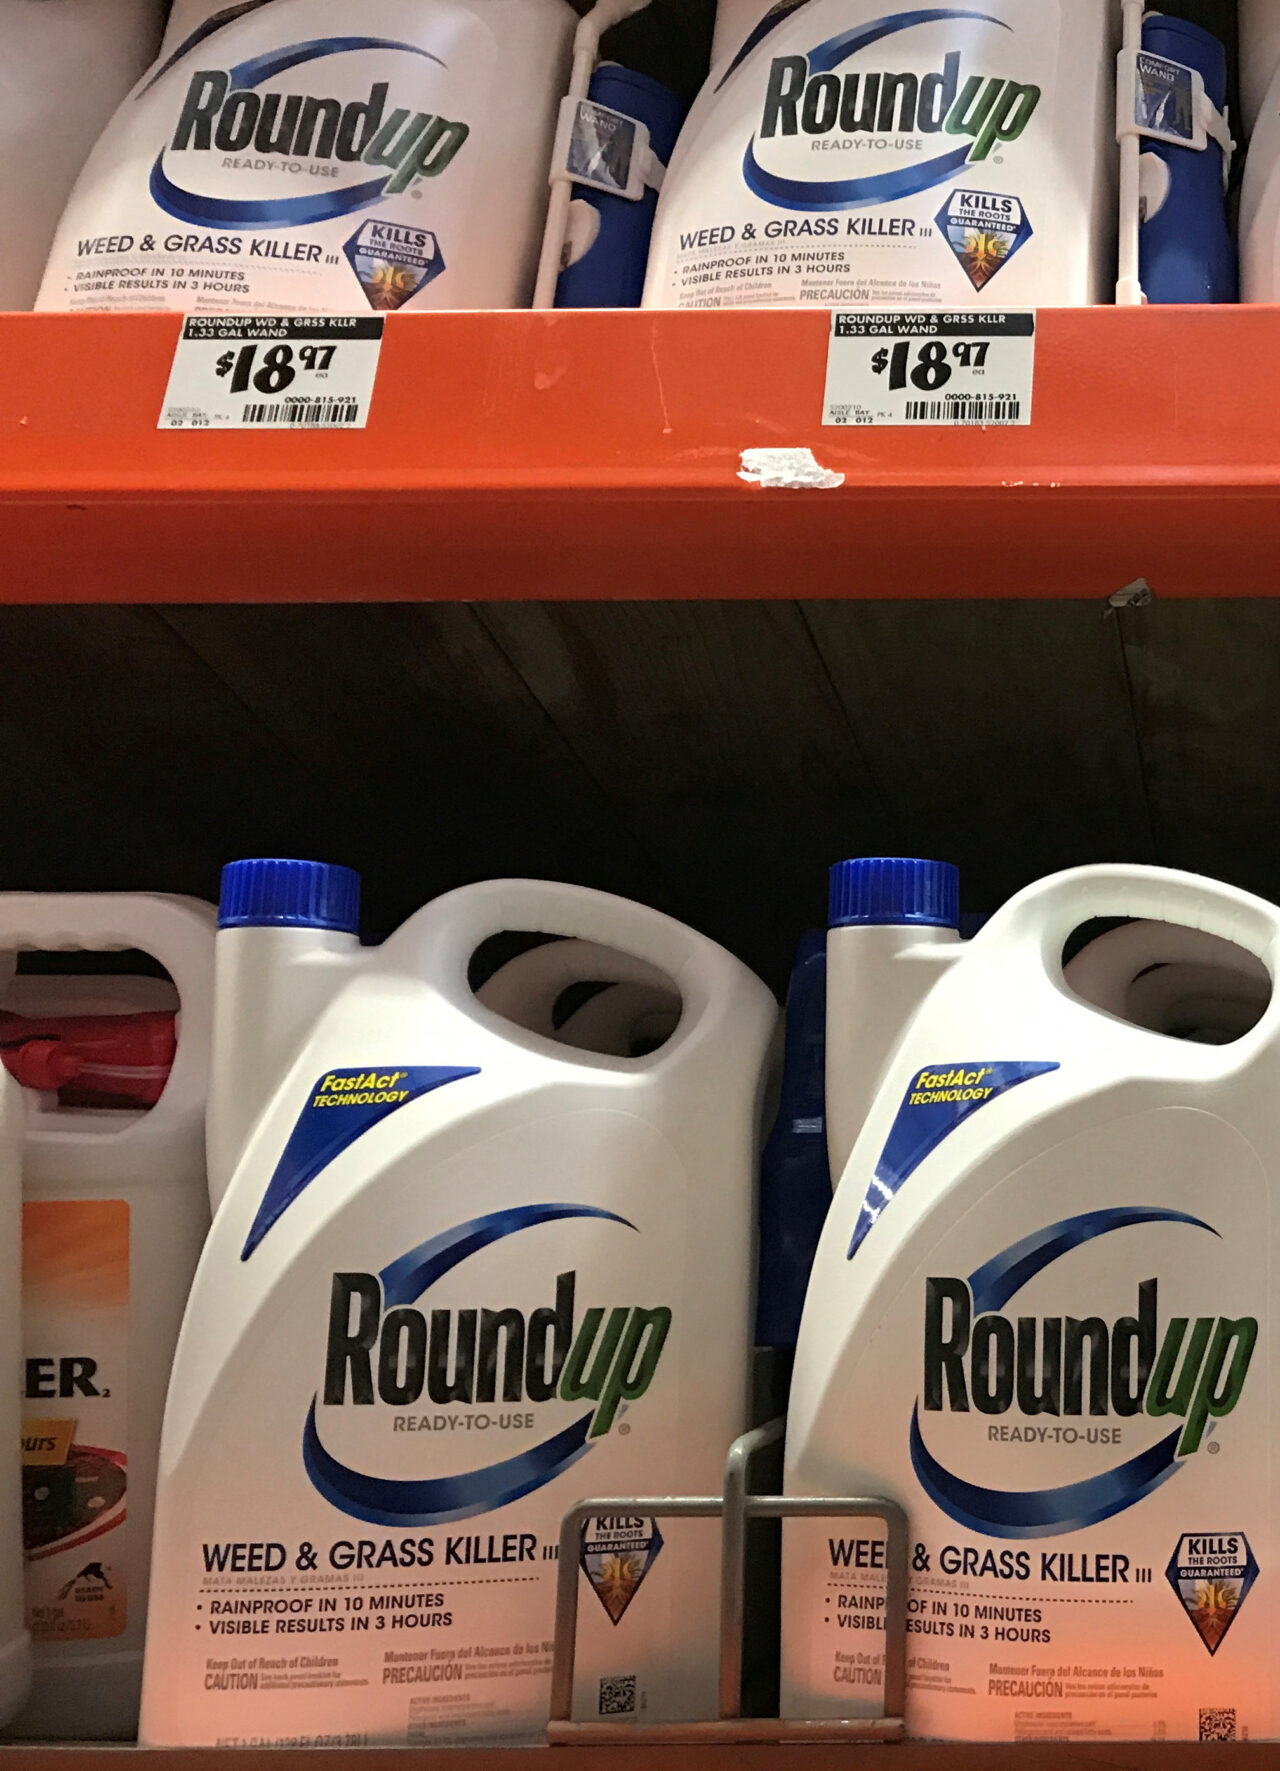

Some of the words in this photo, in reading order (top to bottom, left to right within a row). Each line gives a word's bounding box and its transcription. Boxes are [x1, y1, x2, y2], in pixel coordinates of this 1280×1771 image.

[1140, 64, 1174, 81] WAND
[760, 51, 1040, 164] Roundup
[171, 70, 469, 196] Roundup
[810, 138, 923, 151] READY-TO-USE
[221, 156, 340, 179] READY-TO-USE
[960, 194, 1012, 213] KILLS
[959, 208, 976, 217] THE
[979, 211, 1011, 221] ROOTS
[679, 226, 735, 250] WEED
[741, 223, 756, 240] &
[765, 219, 839, 238] GRASS
[847, 218, 915, 236] KILLER
[950, 218, 1013, 231] GUARANTEED
[371, 225, 426, 247] KILLS
[78, 235, 134, 256] WEED
[139, 234, 155, 252] &
[164, 235, 242, 255] GRASS
[249, 239, 322, 262] KILLER
[683, 255, 752, 274] RAINPROOF
[756, 255, 768, 264] IN
[773, 254, 786, 263] 10
[791, 252, 845, 261] MINUTES
[681, 271, 721, 287] VISIBLE
[725, 267, 773, 279] RESULTS
[777, 265, 790, 274] IN
[795, 265, 801, 273] 3
[807, 264, 850, 273] HOURS
[189, 318, 251, 327] ROUNDUP
[255, 318, 276, 326] WD
[280, 318, 289, 326] &
[294, 319, 325, 327] GRSS
[329, 319, 357, 327] KLLR
[839, 315, 900, 323] ROUNDUP
[904, 315, 925, 323] WD
[929, 315, 938, 323] &
[943, 315, 974, 323] GRSS
[979, 315, 1005, 323] KLLR
[188, 329, 214, 337] 1.33
[218, 329, 242, 337] GAL
[247, 329, 288, 337] WAND
[839, 326, 865, 334] 1.33
[313, 1091, 409, 1107] TECHNOLOGY
[909, 1088, 993, 1105] TECHNOLOGY
[324, 1270, 672, 1438] Roundup
[924, 1277, 1258, 1458] Roundup
[393, 1413, 534, 1432] READY-TO-USE
[988, 1426, 1121, 1445] READY-TO-USE
[202, 1543, 286, 1572] WEED
[296, 1542, 318, 1570] &
[329, 1538, 434, 1569] GRASS
[445, 1534, 537, 1565] KILLER
[1188, 1538, 1238, 1555] KILLS
[829, 1539, 888, 1569] WEE
[912, 1543, 930, 1572] &
[940, 1546, 1030, 1580] GRASS
[1041, 1553, 1129, 1583] KILLER
[1136, 1568, 1151, 1583] III
[1188, 1557, 1204, 1565] THE
[1207, 1556, 1237, 1564] ROOTS
[1180, 1568, 1241, 1577] GUARANTEED
[211, 1599, 312, 1614] RAINPROOF
[319, 1598, 336, 1612] IN
[344, 1597, 363, 1611] 10
[369, 1593, 444, 1610] MINUTES
[209, 1620, 269, 1634] VISIBLE
[276, 1618, 345, 1633] RESULTS
[351, 1617, 368, 1630] IN
[375, 1616, 385, 1629] 3
[392, 1612, 452, 1629] HOURS
[205, 1673, 258, 1690] CAUTION
